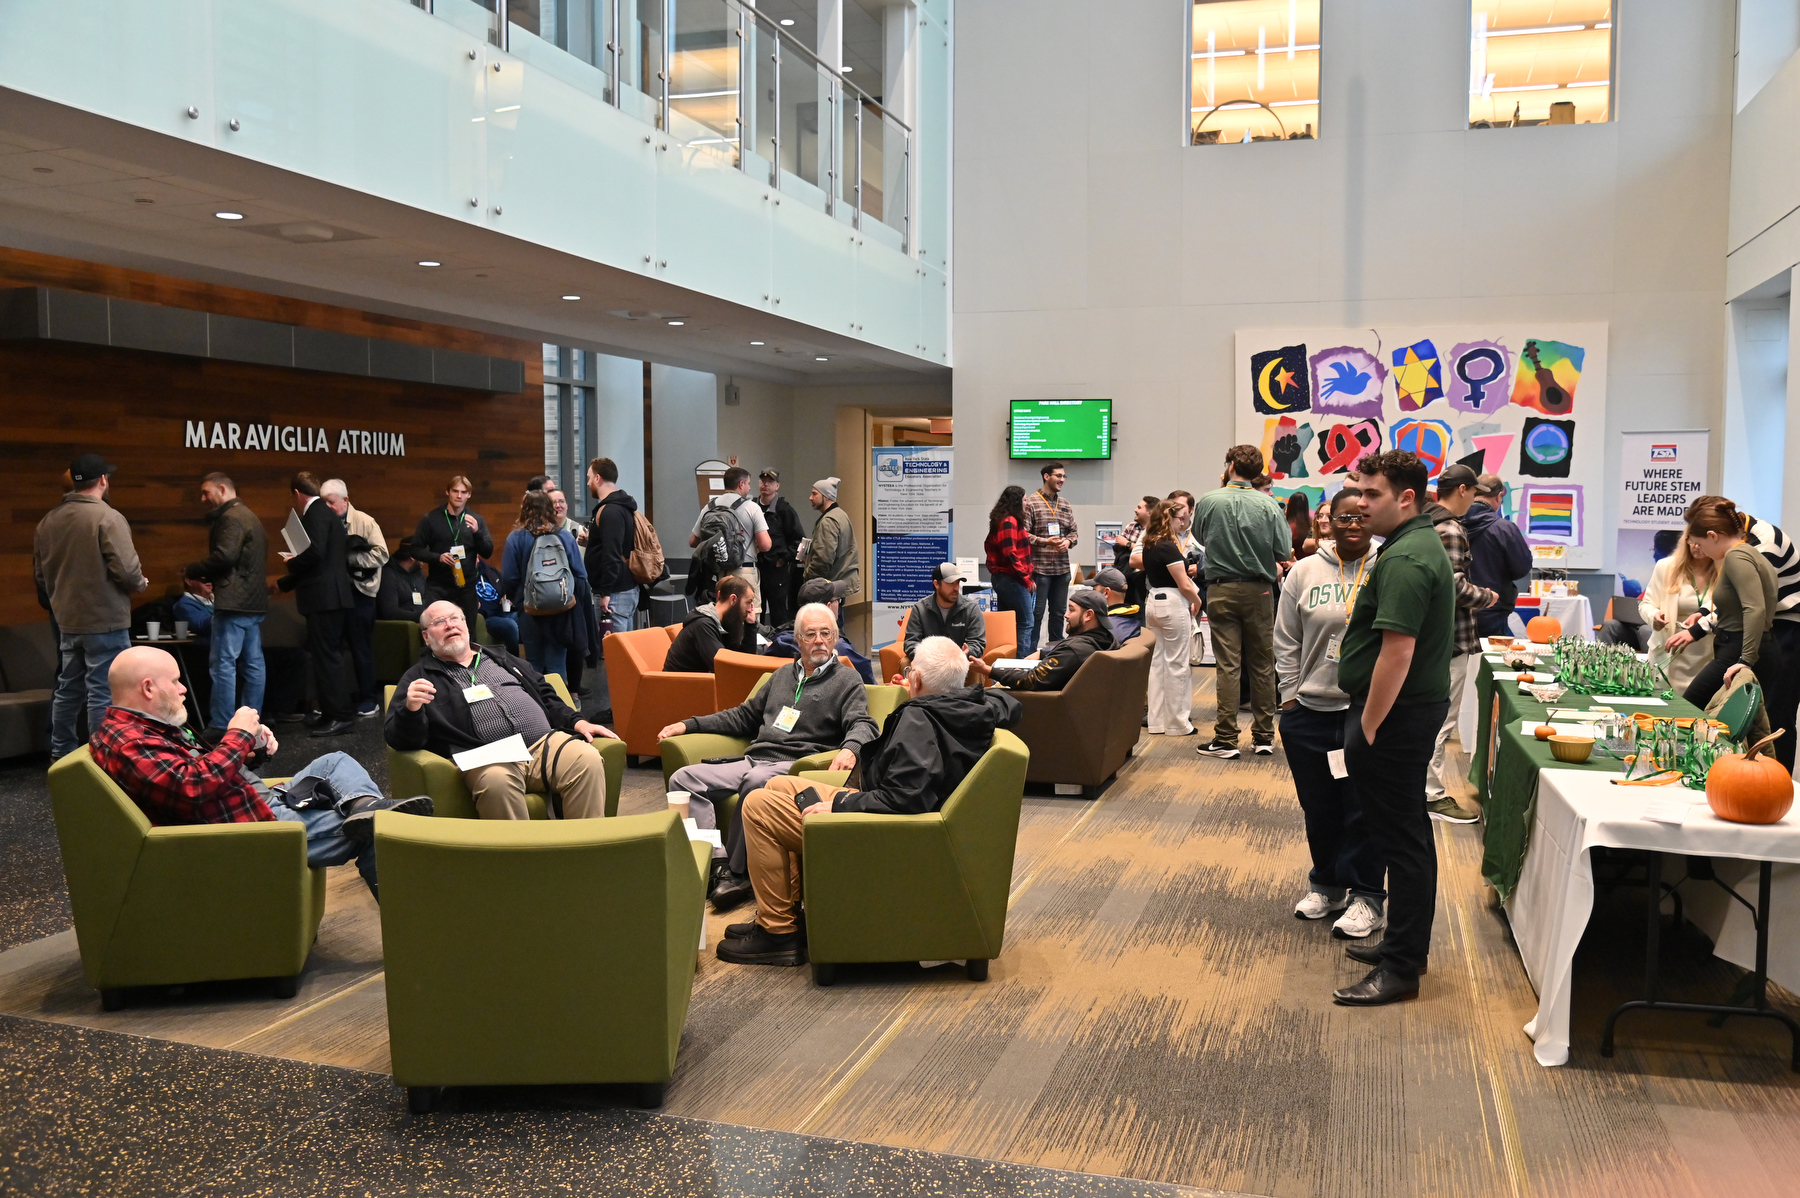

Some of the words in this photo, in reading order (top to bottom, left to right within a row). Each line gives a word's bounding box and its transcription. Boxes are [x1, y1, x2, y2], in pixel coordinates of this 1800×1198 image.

[186, 420, 330, 452] MARAVIGLIA
[337, 430, 406, 456] ATRIUM
[1652, 448, 1676, 458] TSA
[1644, 469, 1682, 478] WHERE
[1625, 481, 1667, 491] FUTURE
[1670, 482, 1701, 491] STEM
[1637, 494, 1686, 504] LEADERS
[1632, 506, 1654, 516] ARE
